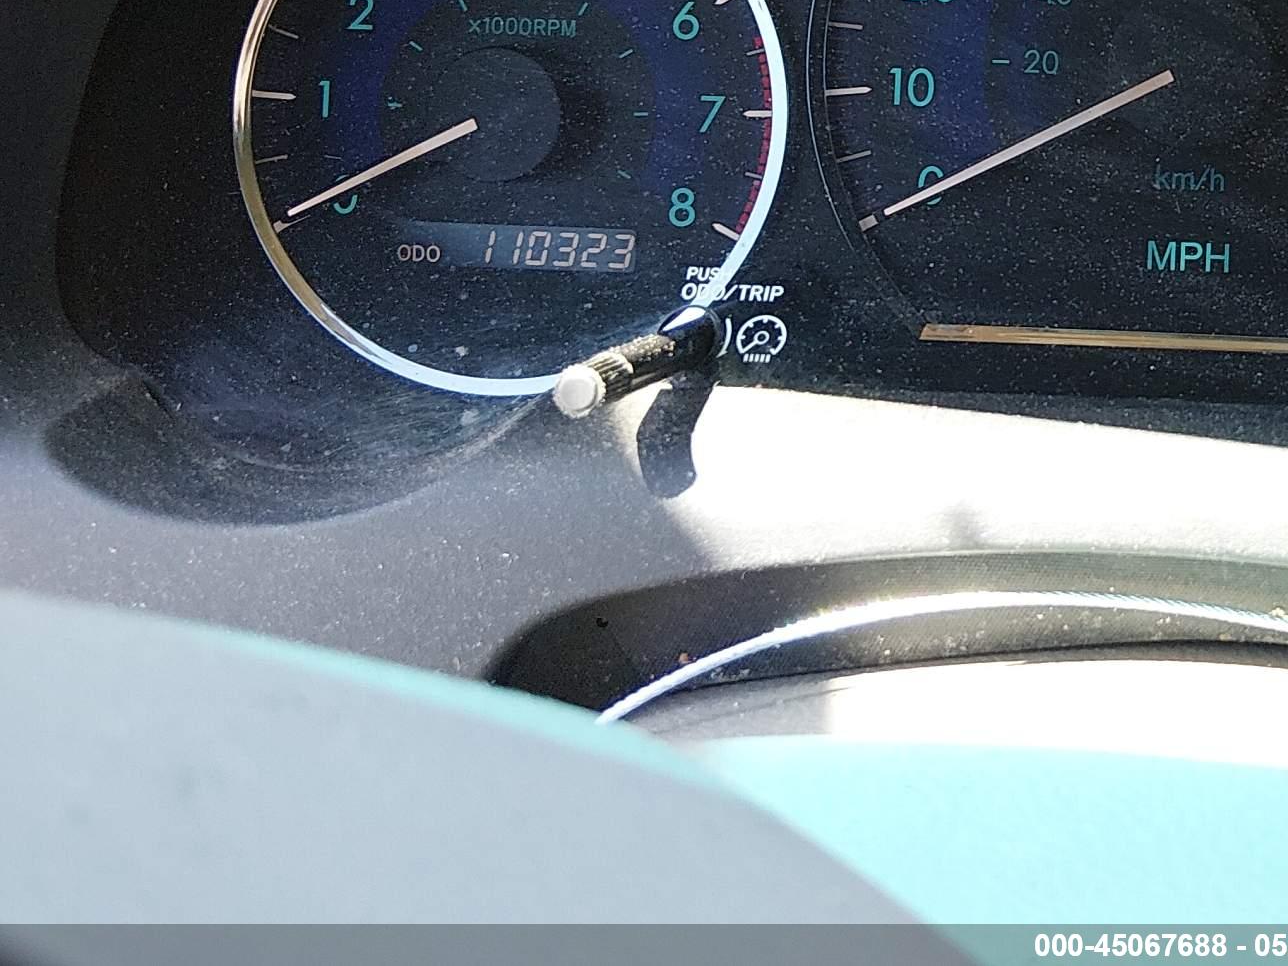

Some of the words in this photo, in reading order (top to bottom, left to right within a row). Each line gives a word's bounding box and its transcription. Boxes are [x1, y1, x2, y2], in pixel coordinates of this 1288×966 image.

[672, 1, 701, 41] 6
[1024, 51, 1059, 75] 20
[319, 81, 330, 117] 1
[890, 69, 934, 106] 10
[701, 96, 726, 133] 7
[1154, 167, 1225, 192] km/h
[669, 188, 697, 227] 8
[399, 244, 441, 262] ODO
[483, 232, 635, 269] 110323
[1147, 243, 1230, 274] MPH
[686, 266, 735, 282] PUS
